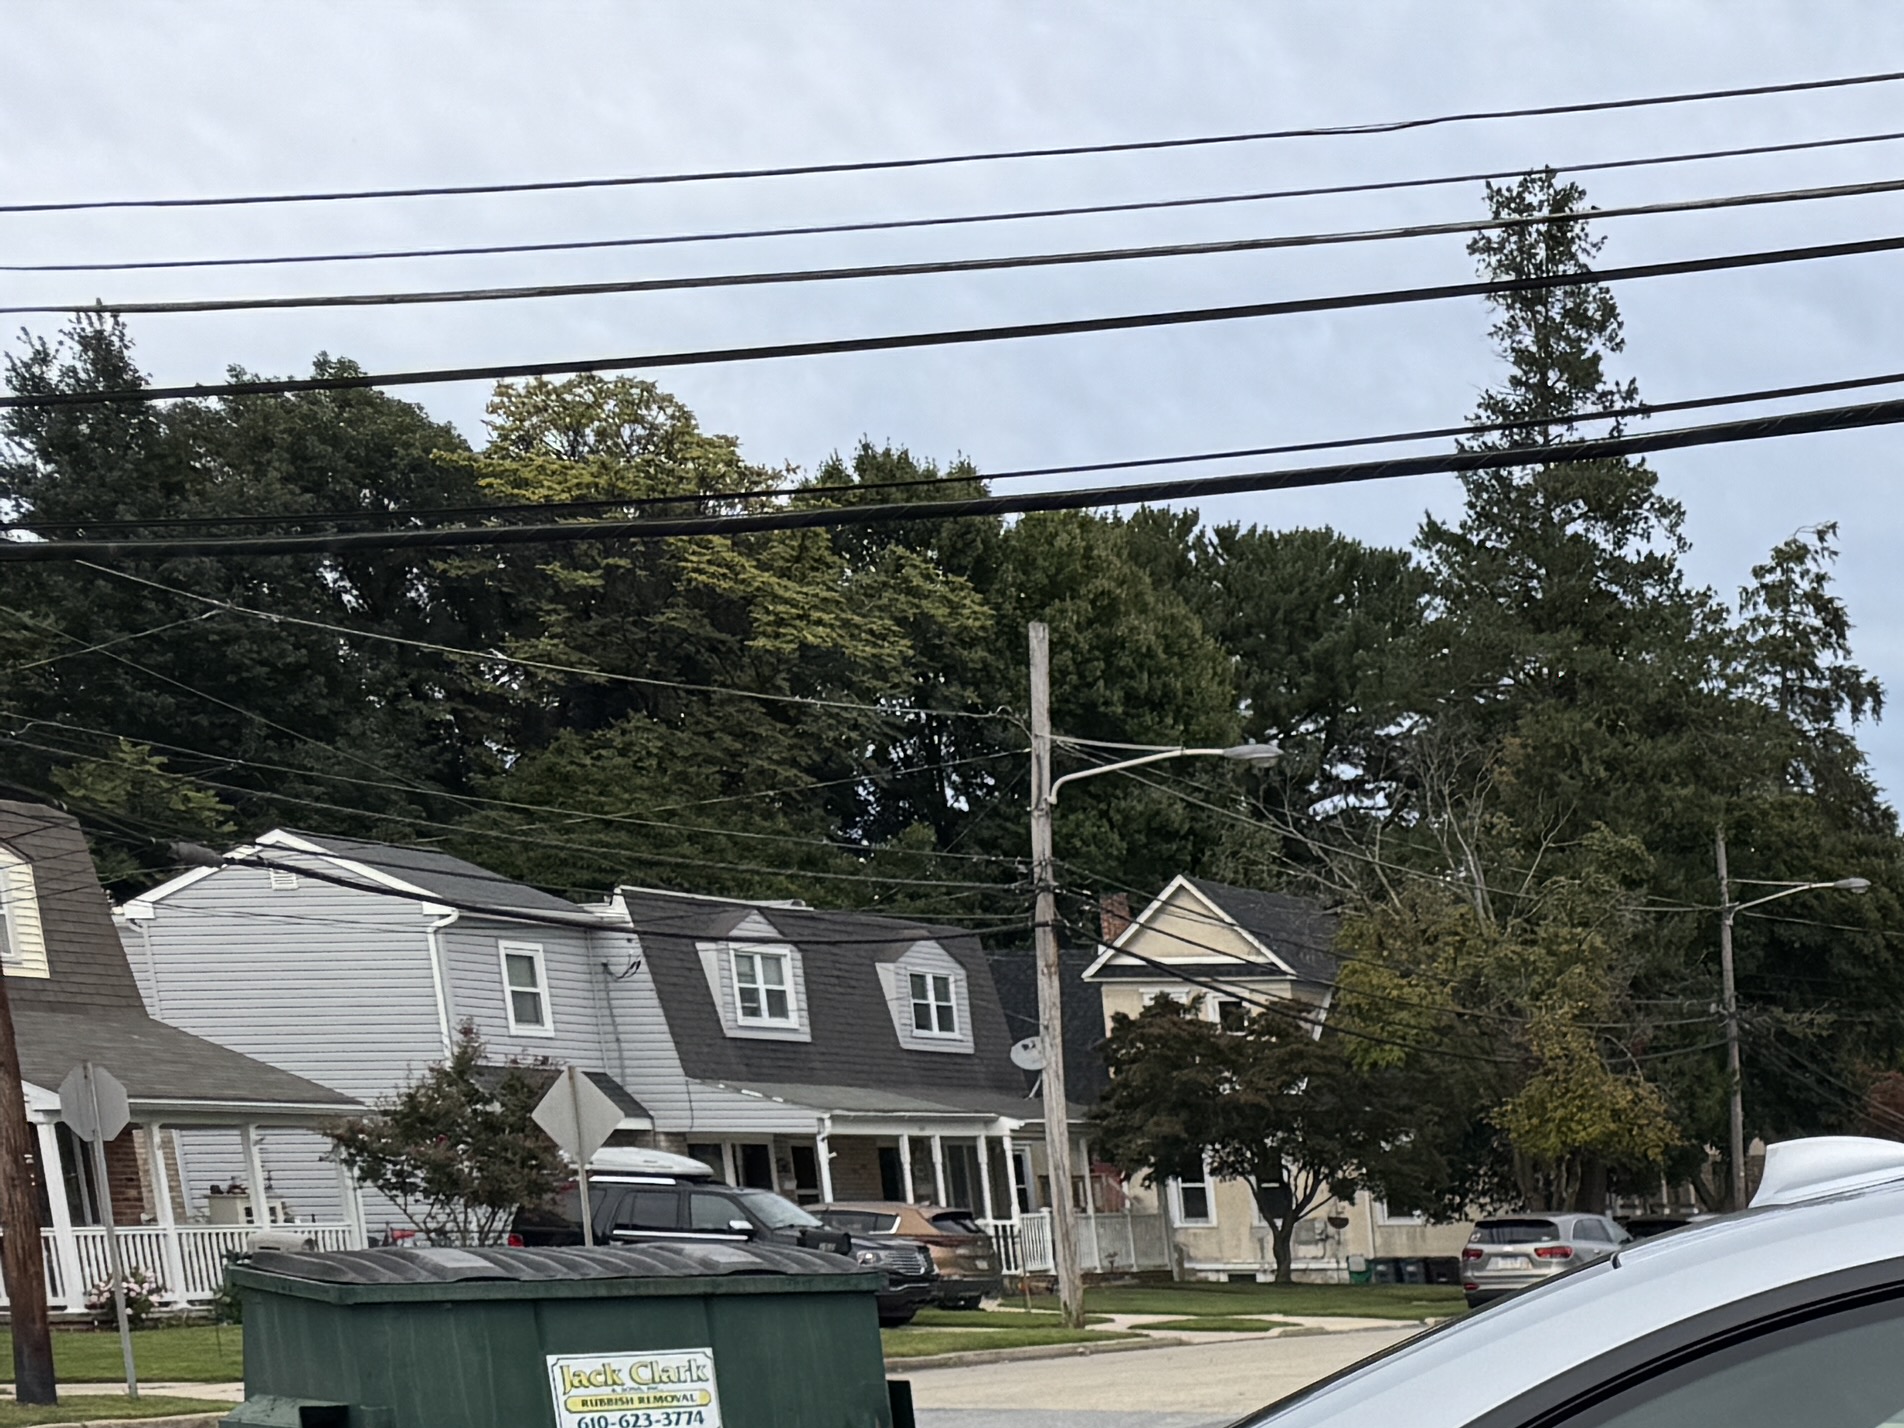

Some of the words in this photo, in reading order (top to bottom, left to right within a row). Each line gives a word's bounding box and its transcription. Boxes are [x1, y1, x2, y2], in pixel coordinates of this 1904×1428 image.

[560, 1363, 625, 1395] Jack
[629, 1358, 710, 1385] Clark
[581, 1396, 634, 1408] RUBBISH
[637, 1393, 697, 1405] REMOVAL
